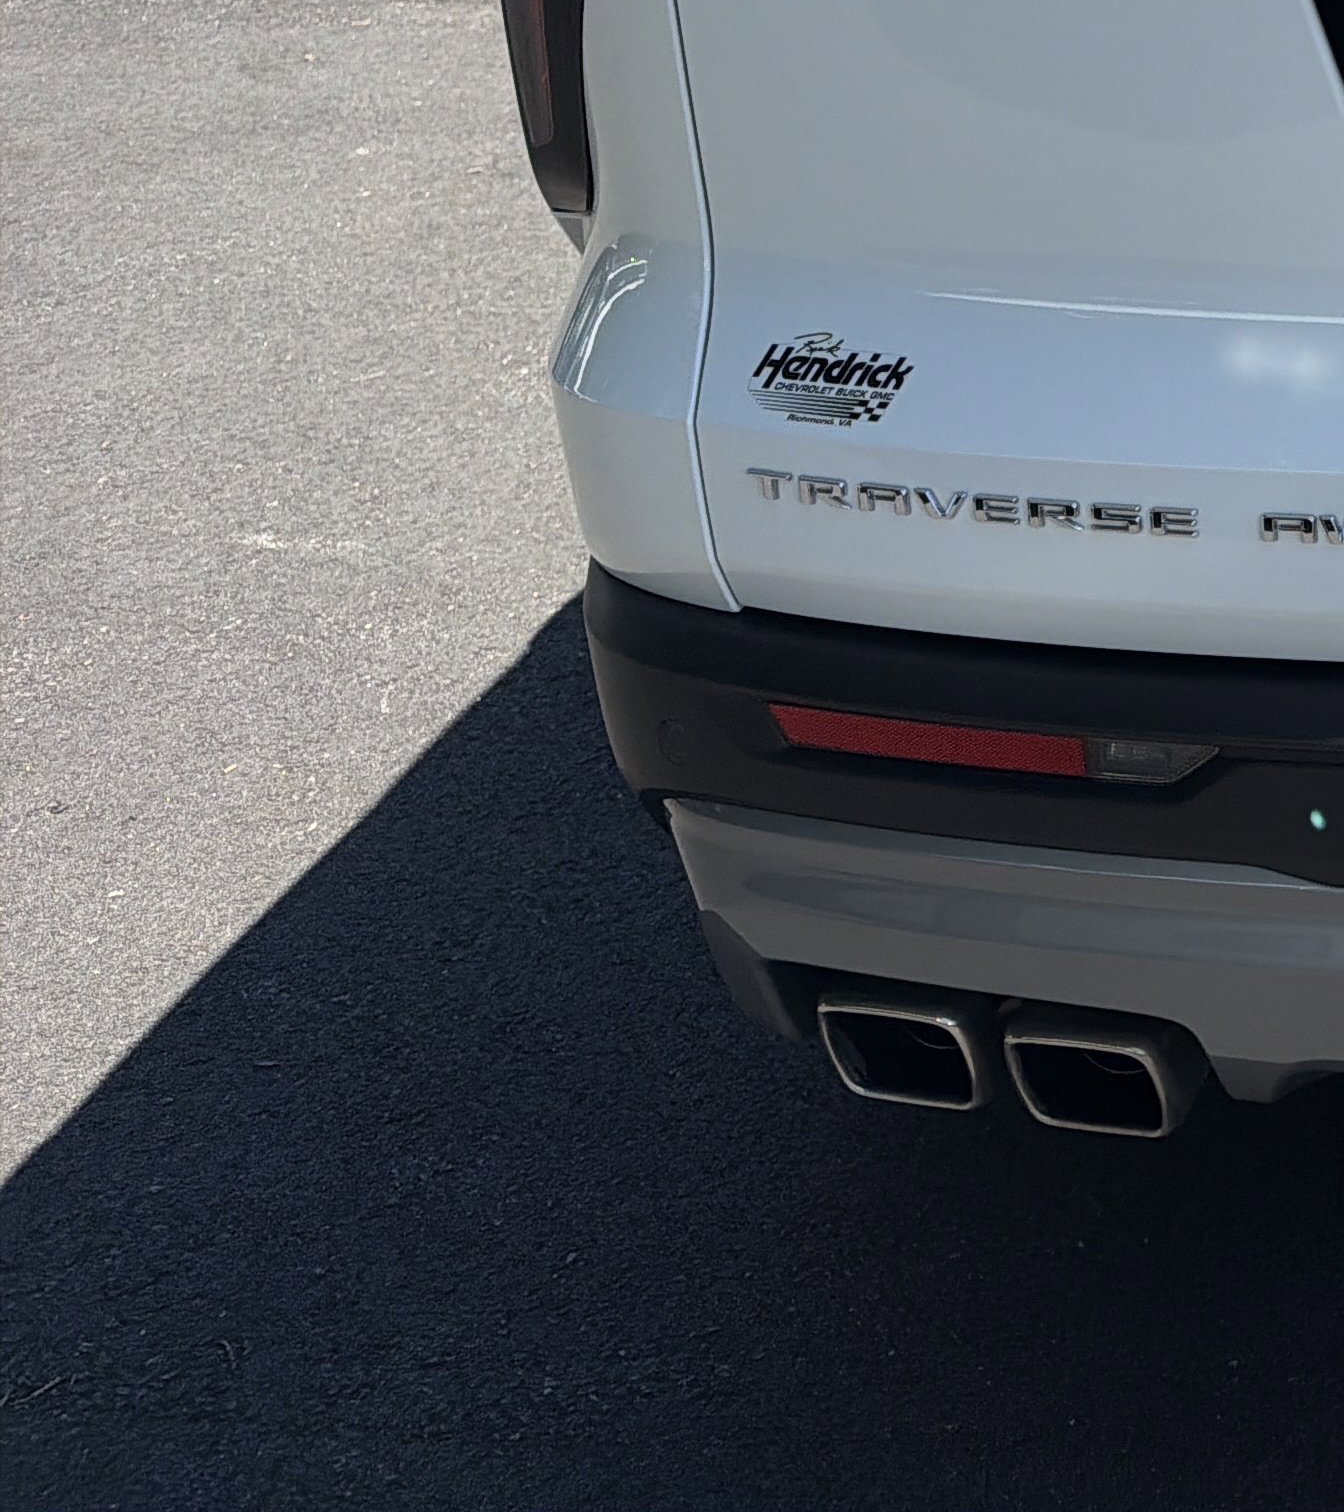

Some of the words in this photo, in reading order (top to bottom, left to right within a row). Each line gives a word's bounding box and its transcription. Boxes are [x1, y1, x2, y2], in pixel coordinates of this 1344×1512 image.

[752, 344, 914, 390] Hendrick
[774, 381, 833, 395] CHEVROLET
[835, 387, 868, 399] BUICK
[870, 392, 895, 401] GMC
[838, 418, 853, 428] VA
[746, 468, 1199, 539] TRAVERSE
